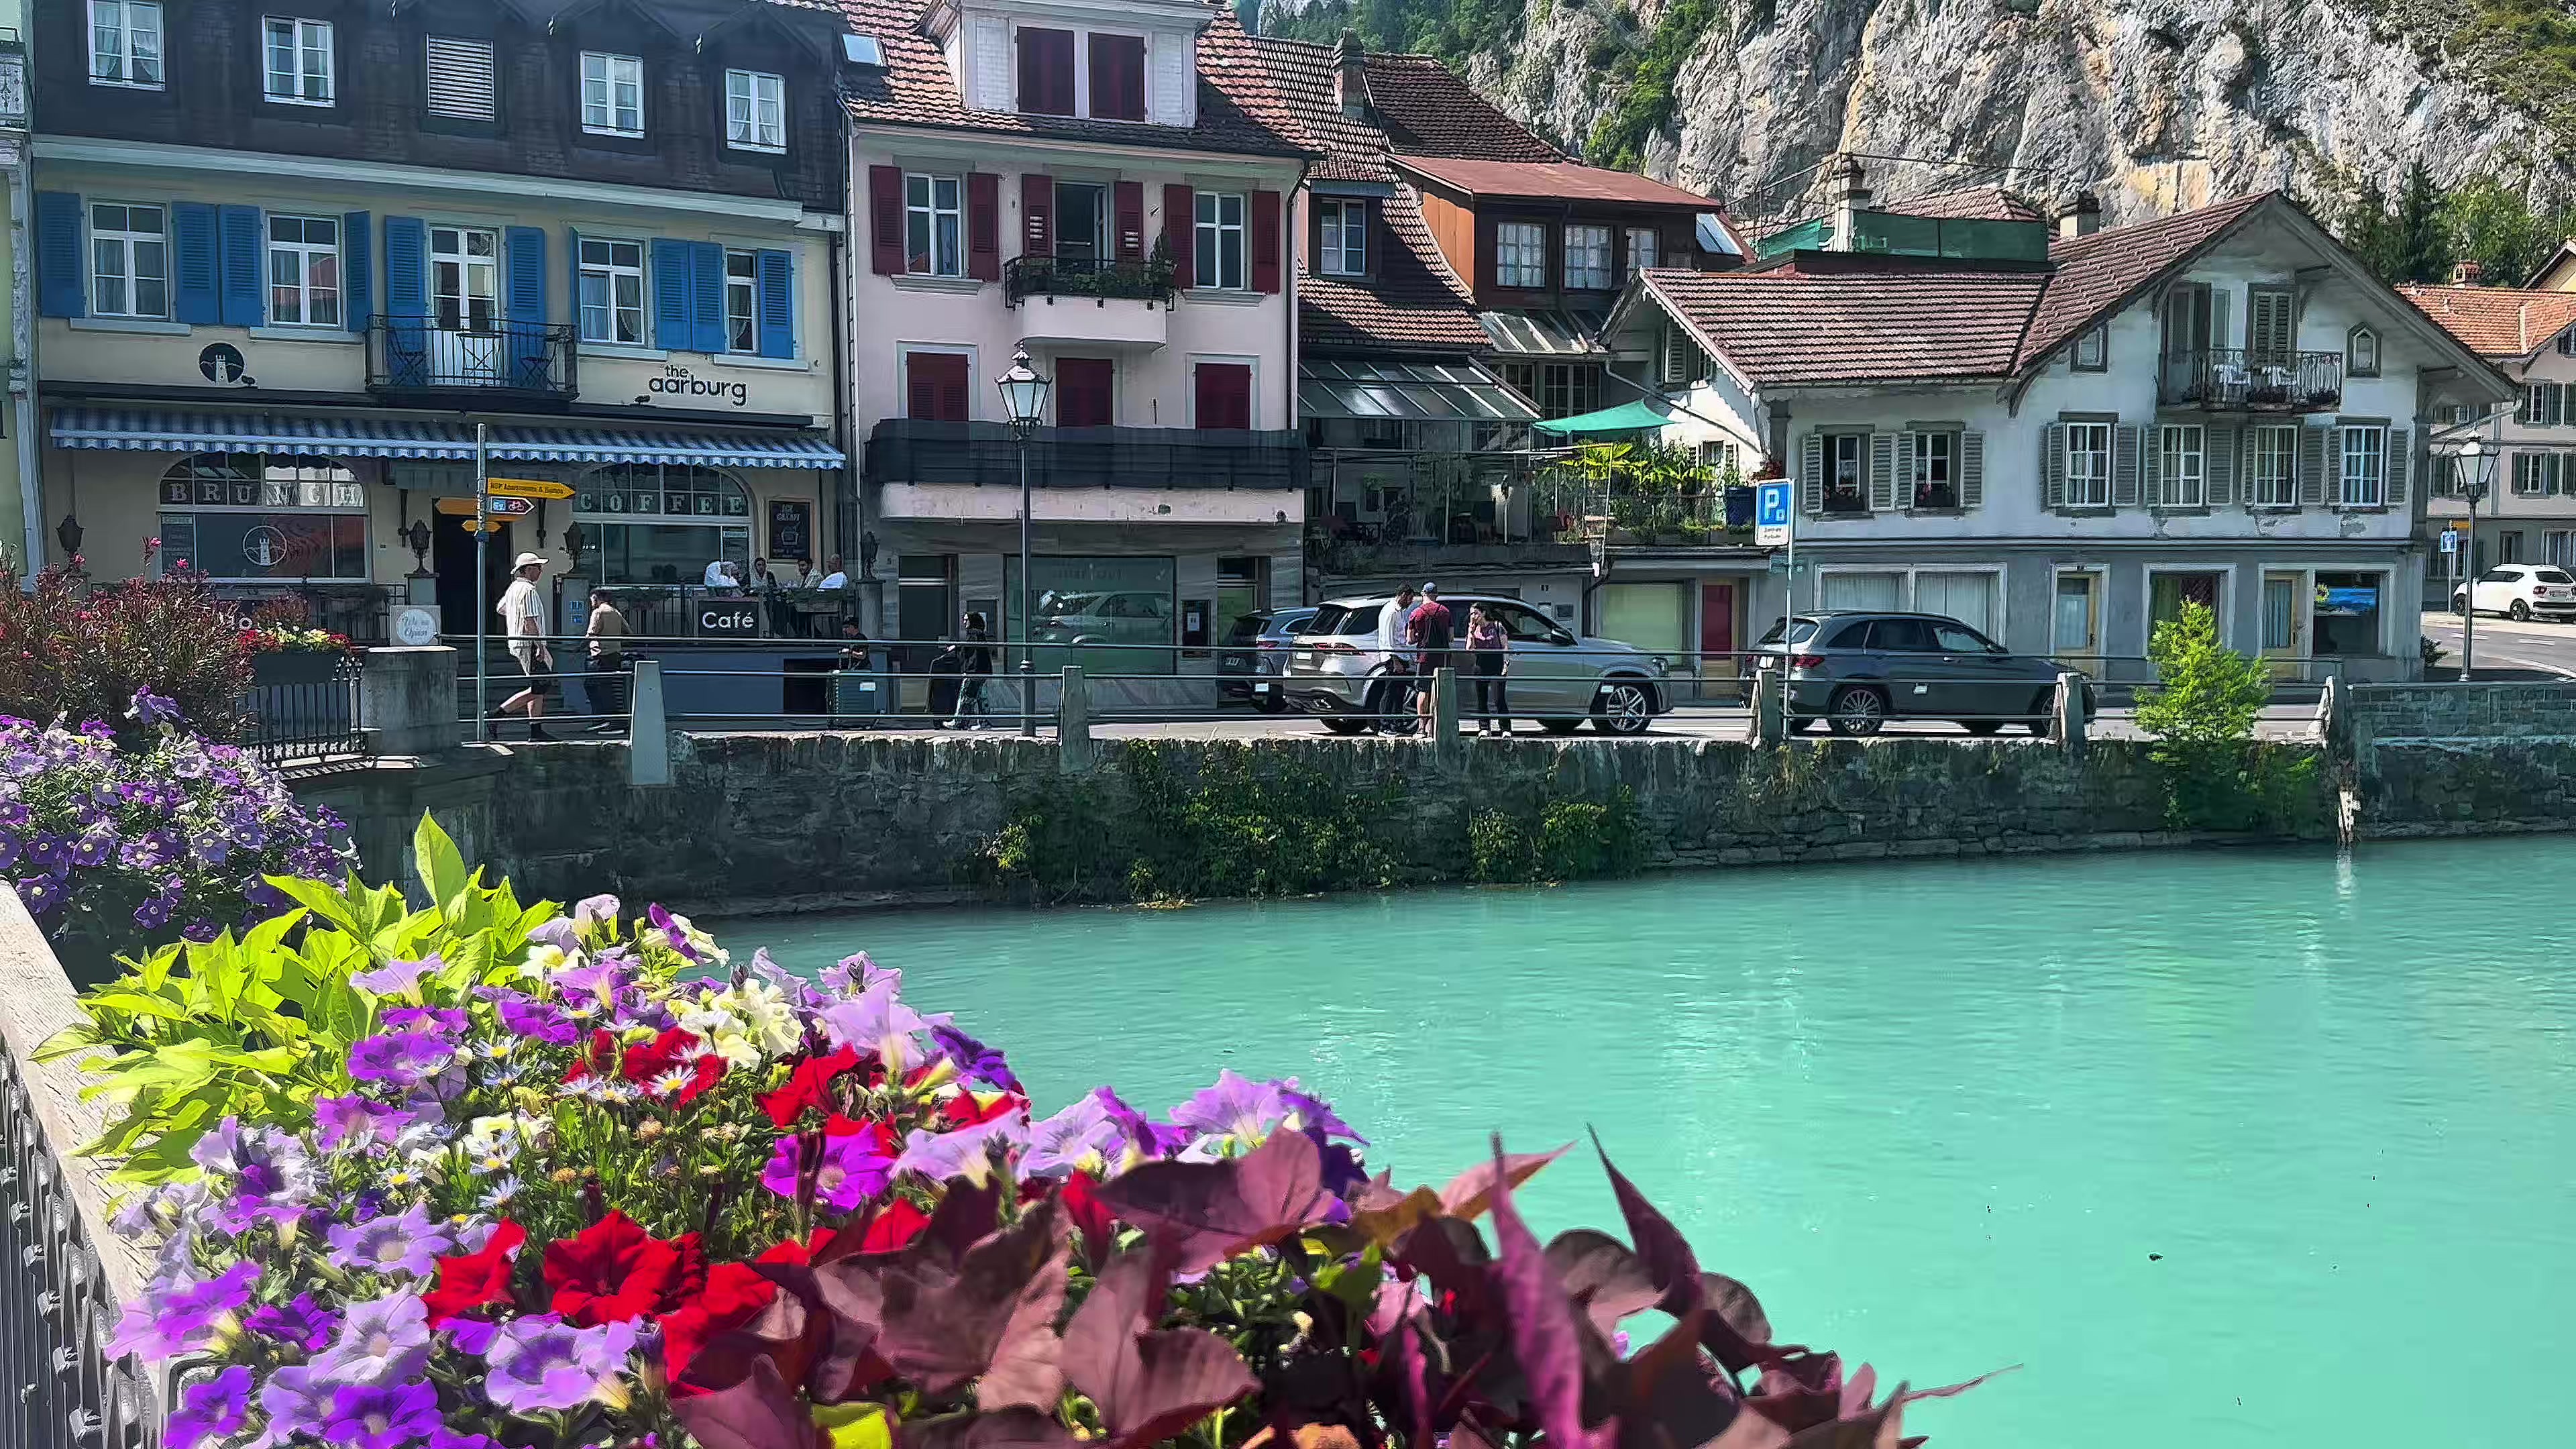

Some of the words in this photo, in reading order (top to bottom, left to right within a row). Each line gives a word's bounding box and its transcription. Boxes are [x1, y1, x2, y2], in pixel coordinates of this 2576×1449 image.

[665, 364, 689, 378] the
[649, 374, 747, 407] aarburg
[171, 482, 358, 506] BRUNCH
[580, 493, 742, 513] COFFEE
[1764, 488, 1780, 521] P
[702, 610, 754, 629] Café
